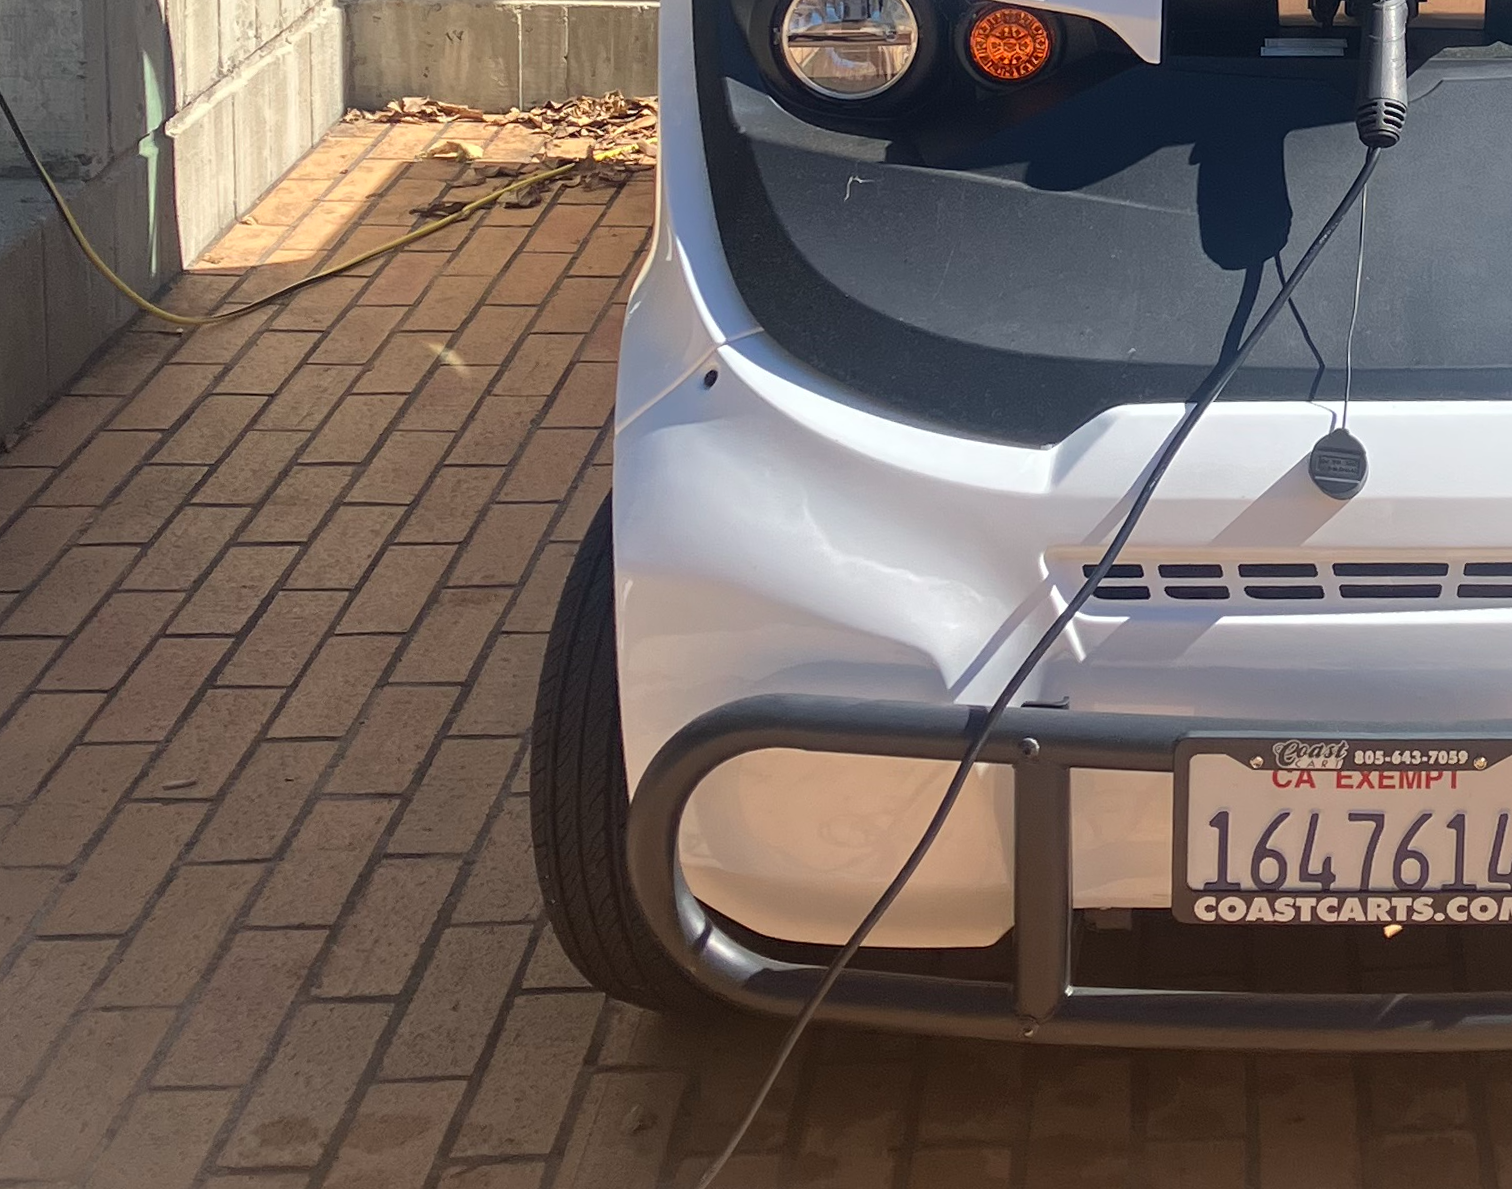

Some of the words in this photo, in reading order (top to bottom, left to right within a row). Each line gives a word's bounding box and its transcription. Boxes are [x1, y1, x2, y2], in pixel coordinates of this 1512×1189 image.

[1273, 739, 1349, 768] Coast
[1354, 750, 1469, 766] 805-643-7059
[1271, 770, 1316, 789] CA
